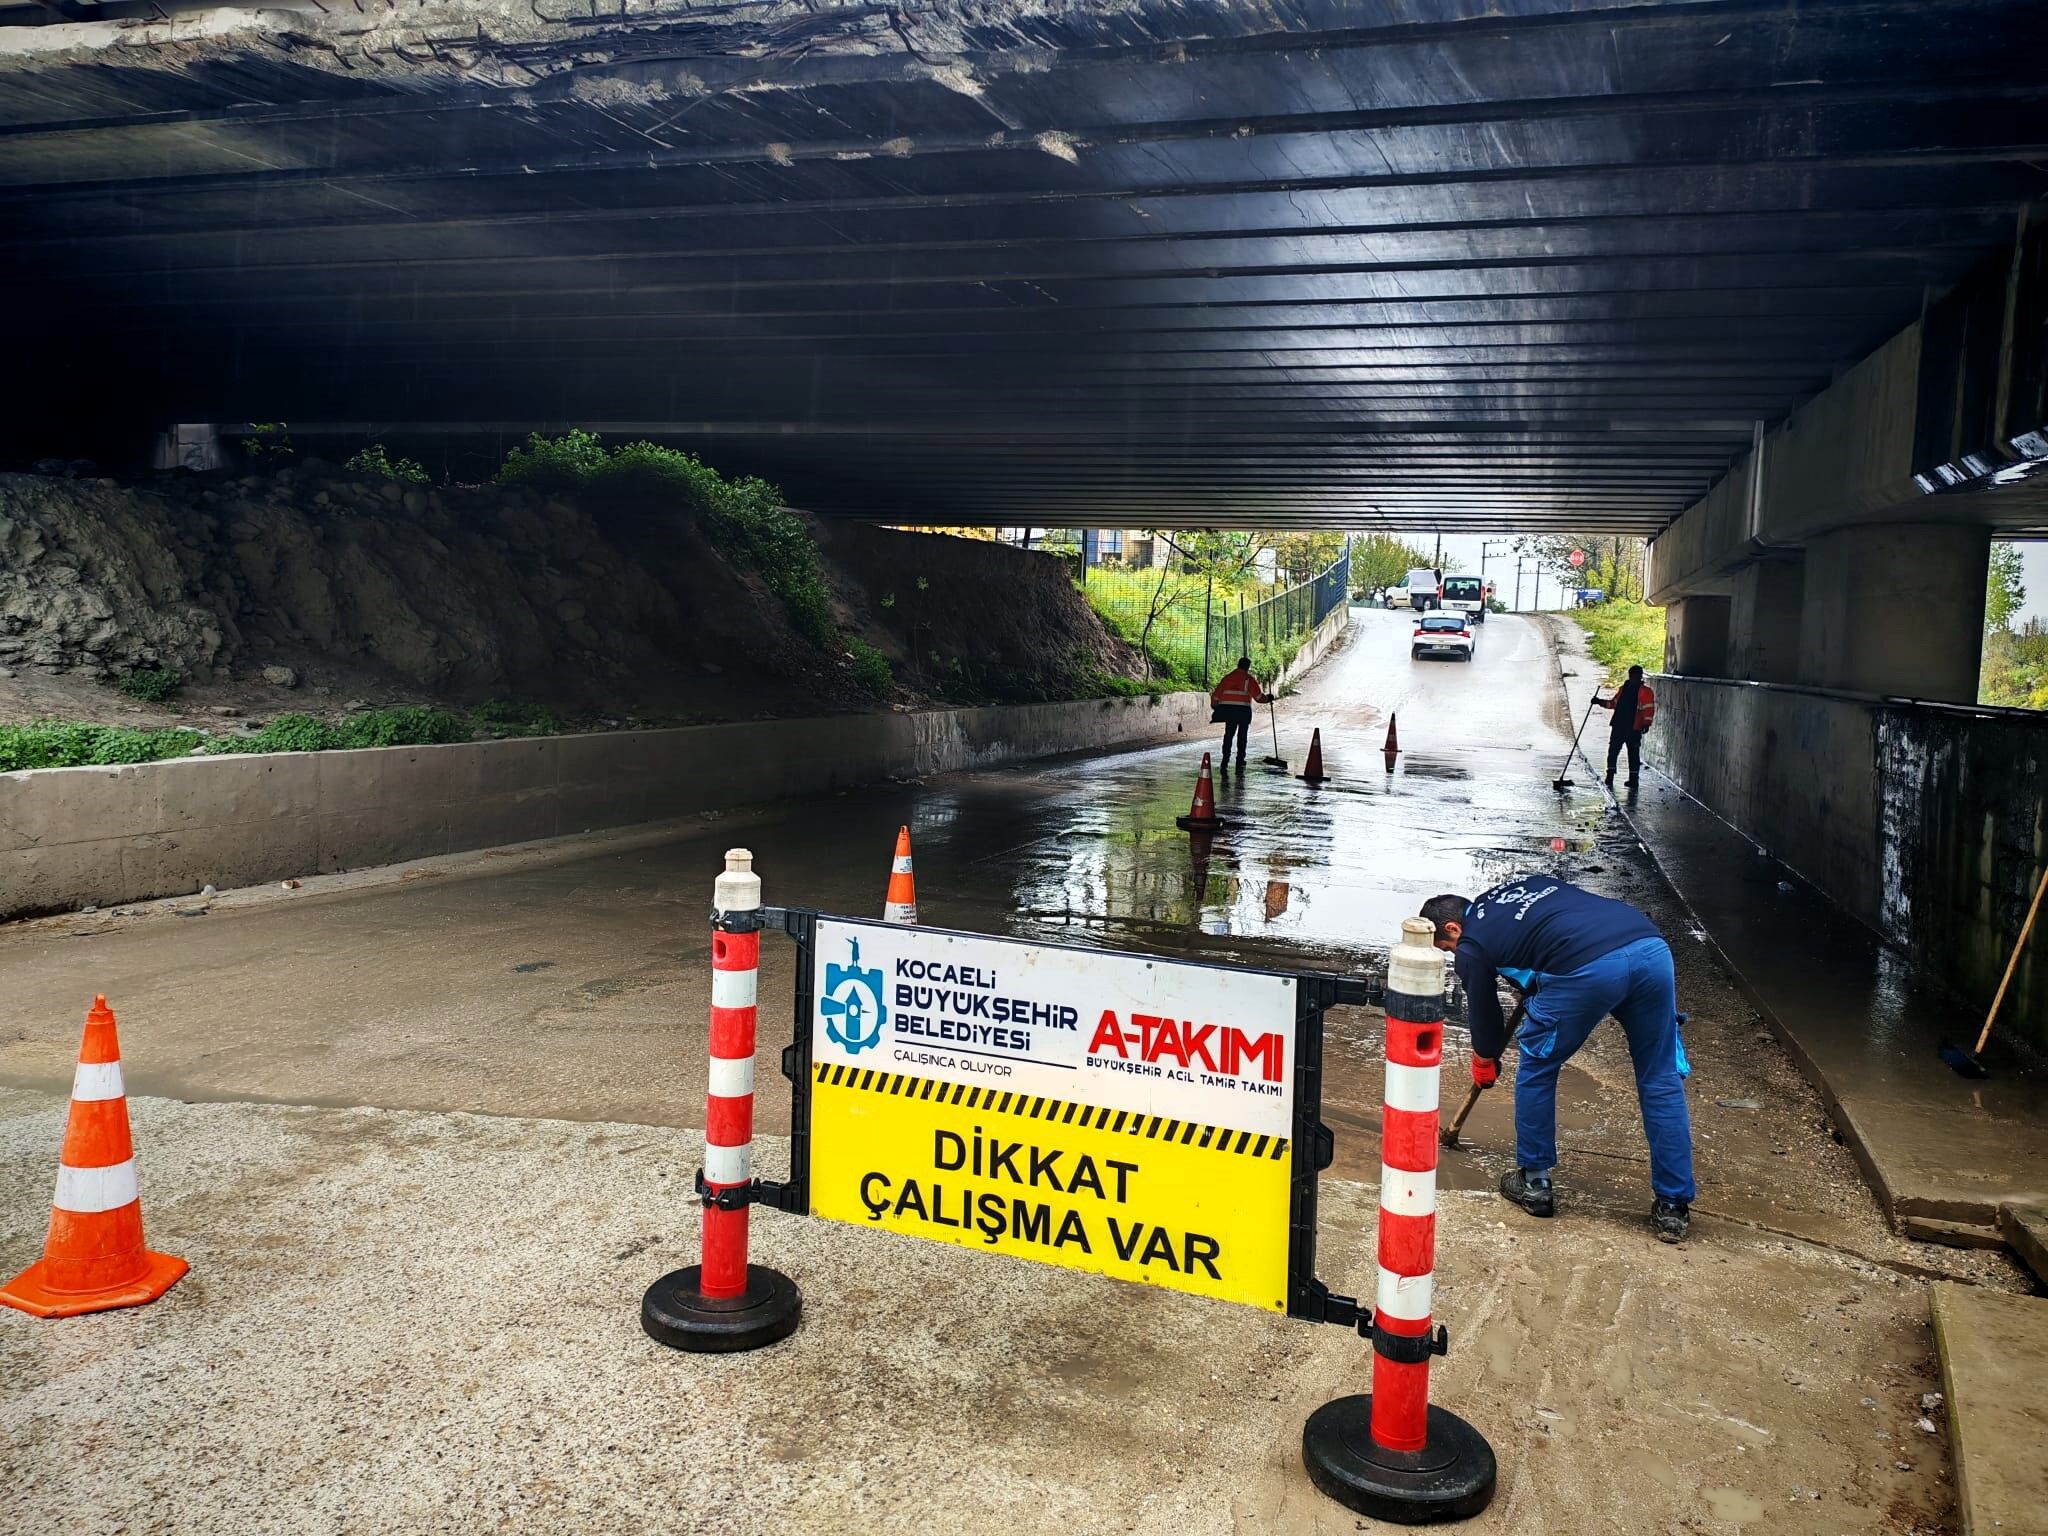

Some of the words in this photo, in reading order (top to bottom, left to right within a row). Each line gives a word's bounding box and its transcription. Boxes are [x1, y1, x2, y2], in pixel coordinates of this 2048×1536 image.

[896, 957, 996, 990] KOCAELİ
[895, 983, 1079, 1031] BÜYÜKŞEHİR
[894, 1013, 1031, 1051] BELEDİYESİ
[1087, 1009, 1284, 1083] A-TAKIMI
[893, 1049, 957, 1070] ÇALIŞINCA
[960, 1060, 1012, 1077] OLUYOR
[1086, 1056, 1162, 1078] BÜYÜKŞEHİR
[1167, 1069, 1195, 1083] ACİL
[1200, 1074, 1236, 1090] TAMİR
[1241, 1080, 1283, 1097] TAKIMI
[934, 1126, 1139, 1204] DİKKAT
[860, 1171, 1093, 1255] ÇALIŞMA
[1106, 1216, 1223, 1281] VAR
